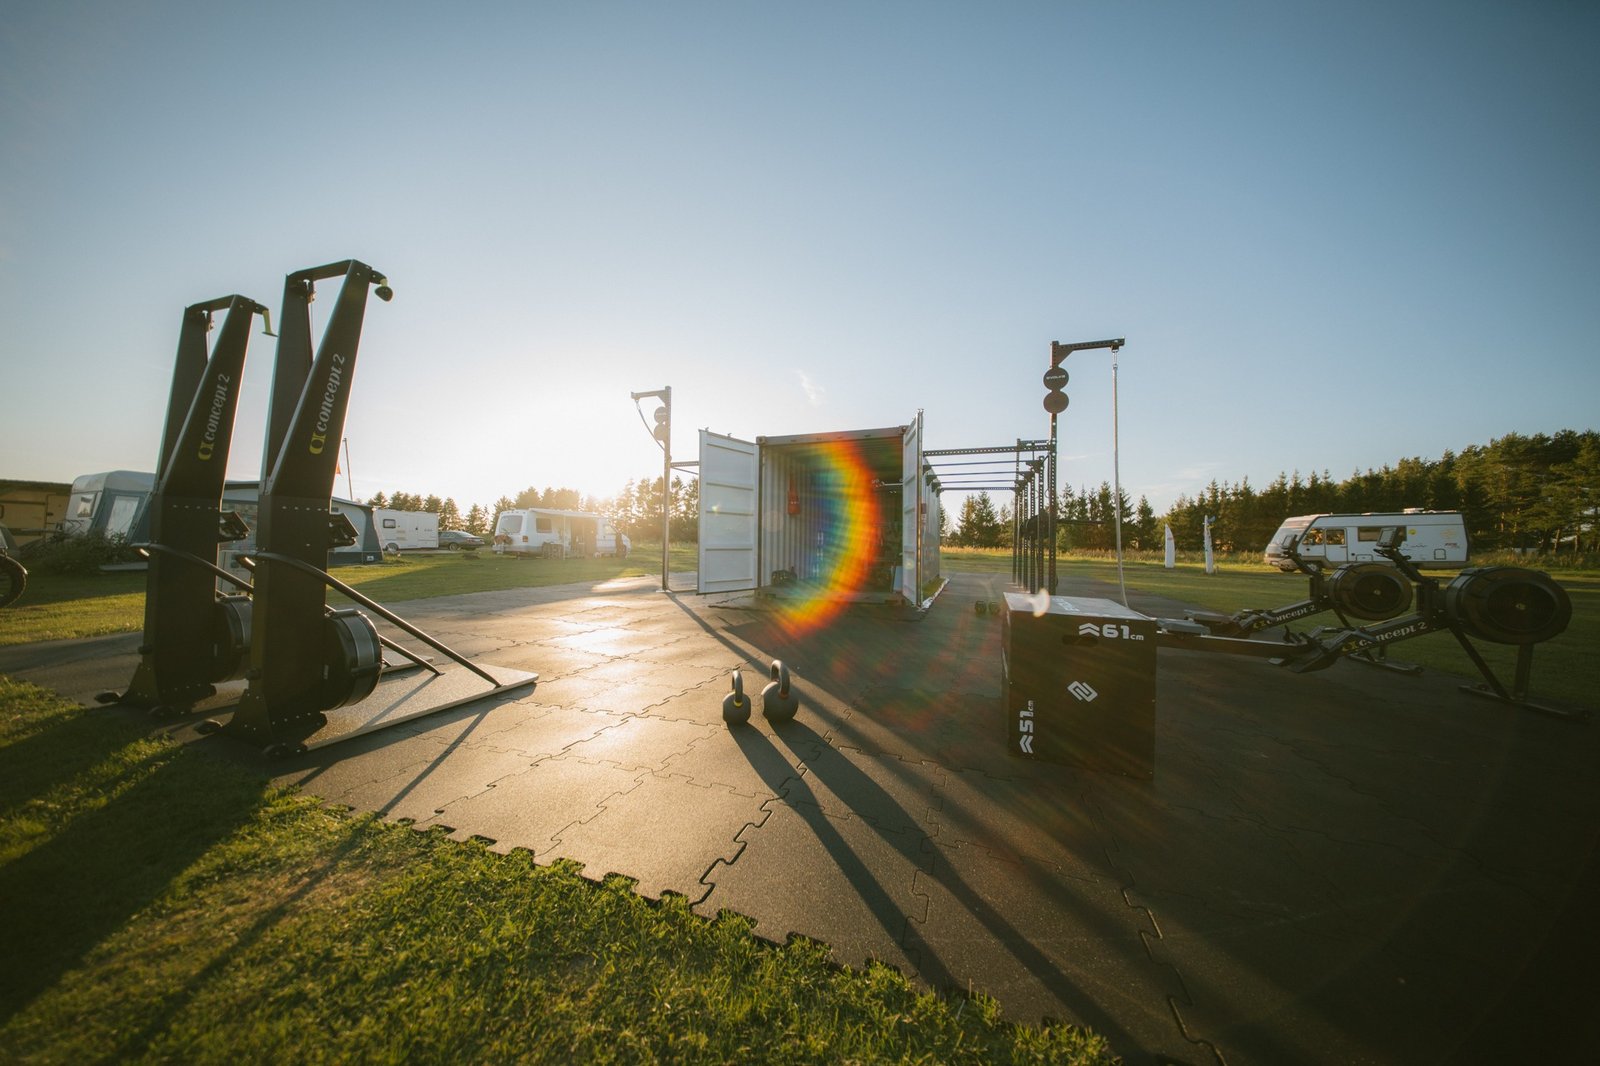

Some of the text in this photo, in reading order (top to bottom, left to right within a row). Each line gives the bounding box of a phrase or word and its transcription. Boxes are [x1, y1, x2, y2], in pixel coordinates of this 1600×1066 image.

[204, 373, 230, 441] concept 2
[316, 353, 345, 432] concept 2
[1358, 621, 1428, 647] cncept 2
